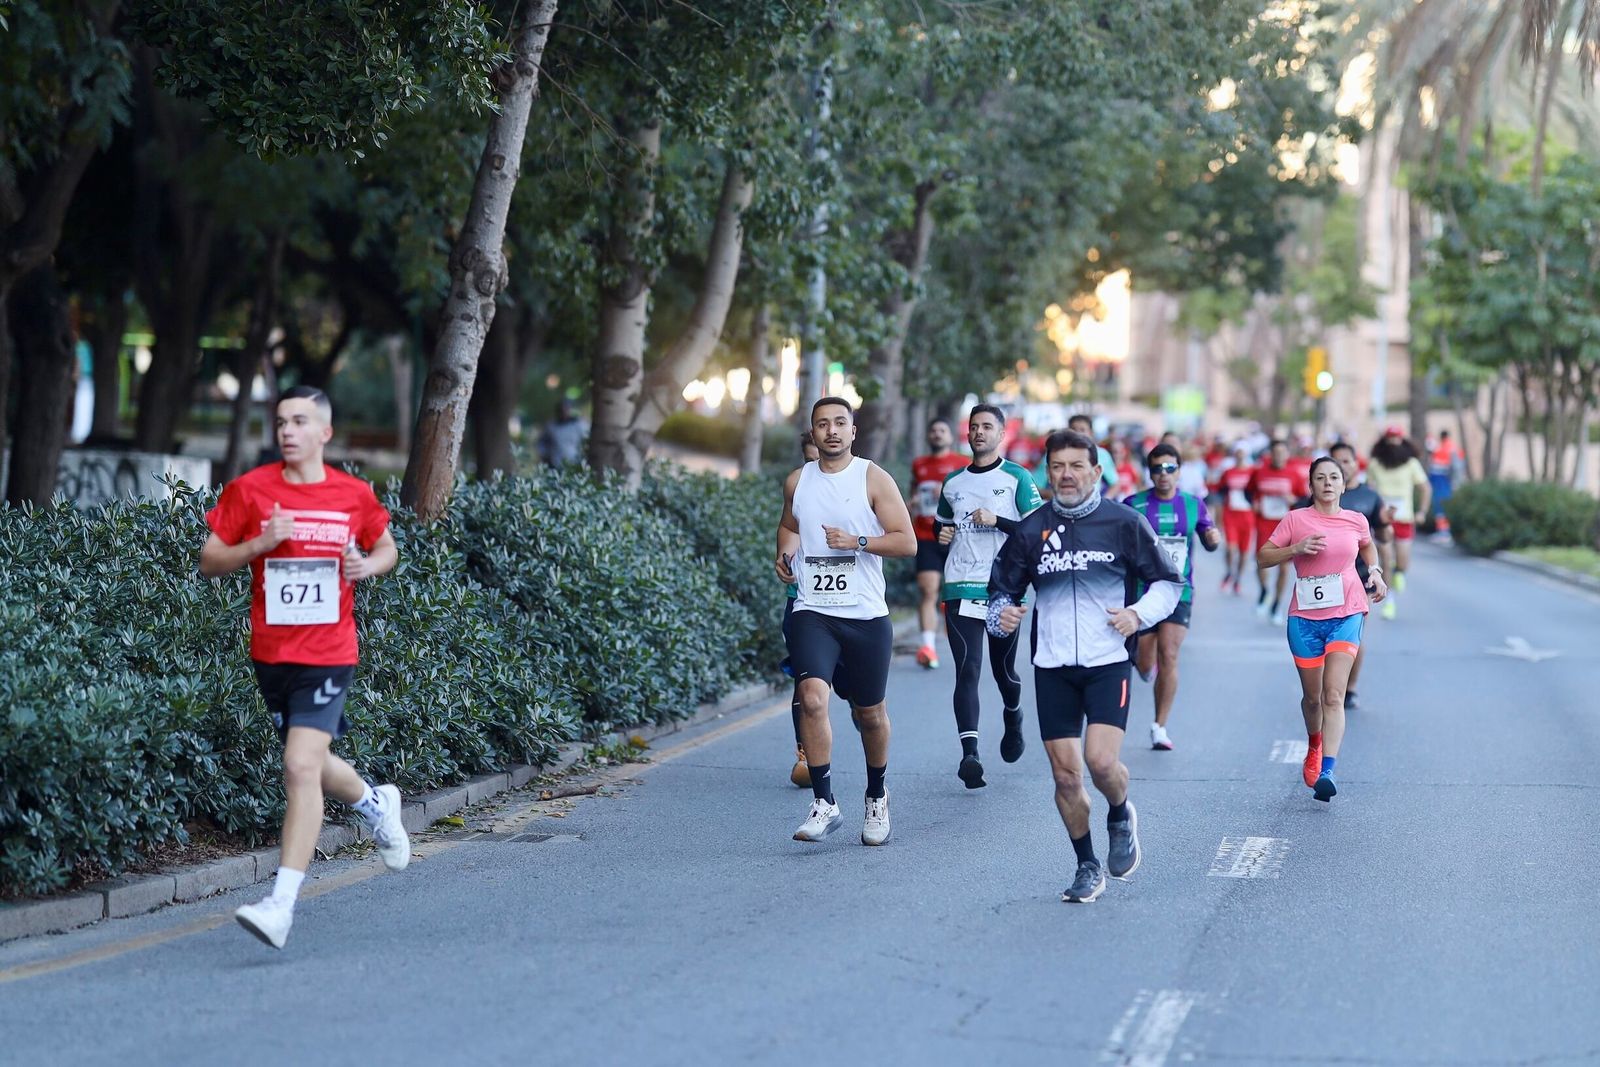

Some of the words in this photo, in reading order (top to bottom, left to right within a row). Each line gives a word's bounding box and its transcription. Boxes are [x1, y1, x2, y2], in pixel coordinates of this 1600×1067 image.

[1040, 550, 1115, 564] CALAMORRO
[813, 574, 847, 591] 226
[280, 583, 324, 605] 671
[1314, 585, 1324, 601] 6
